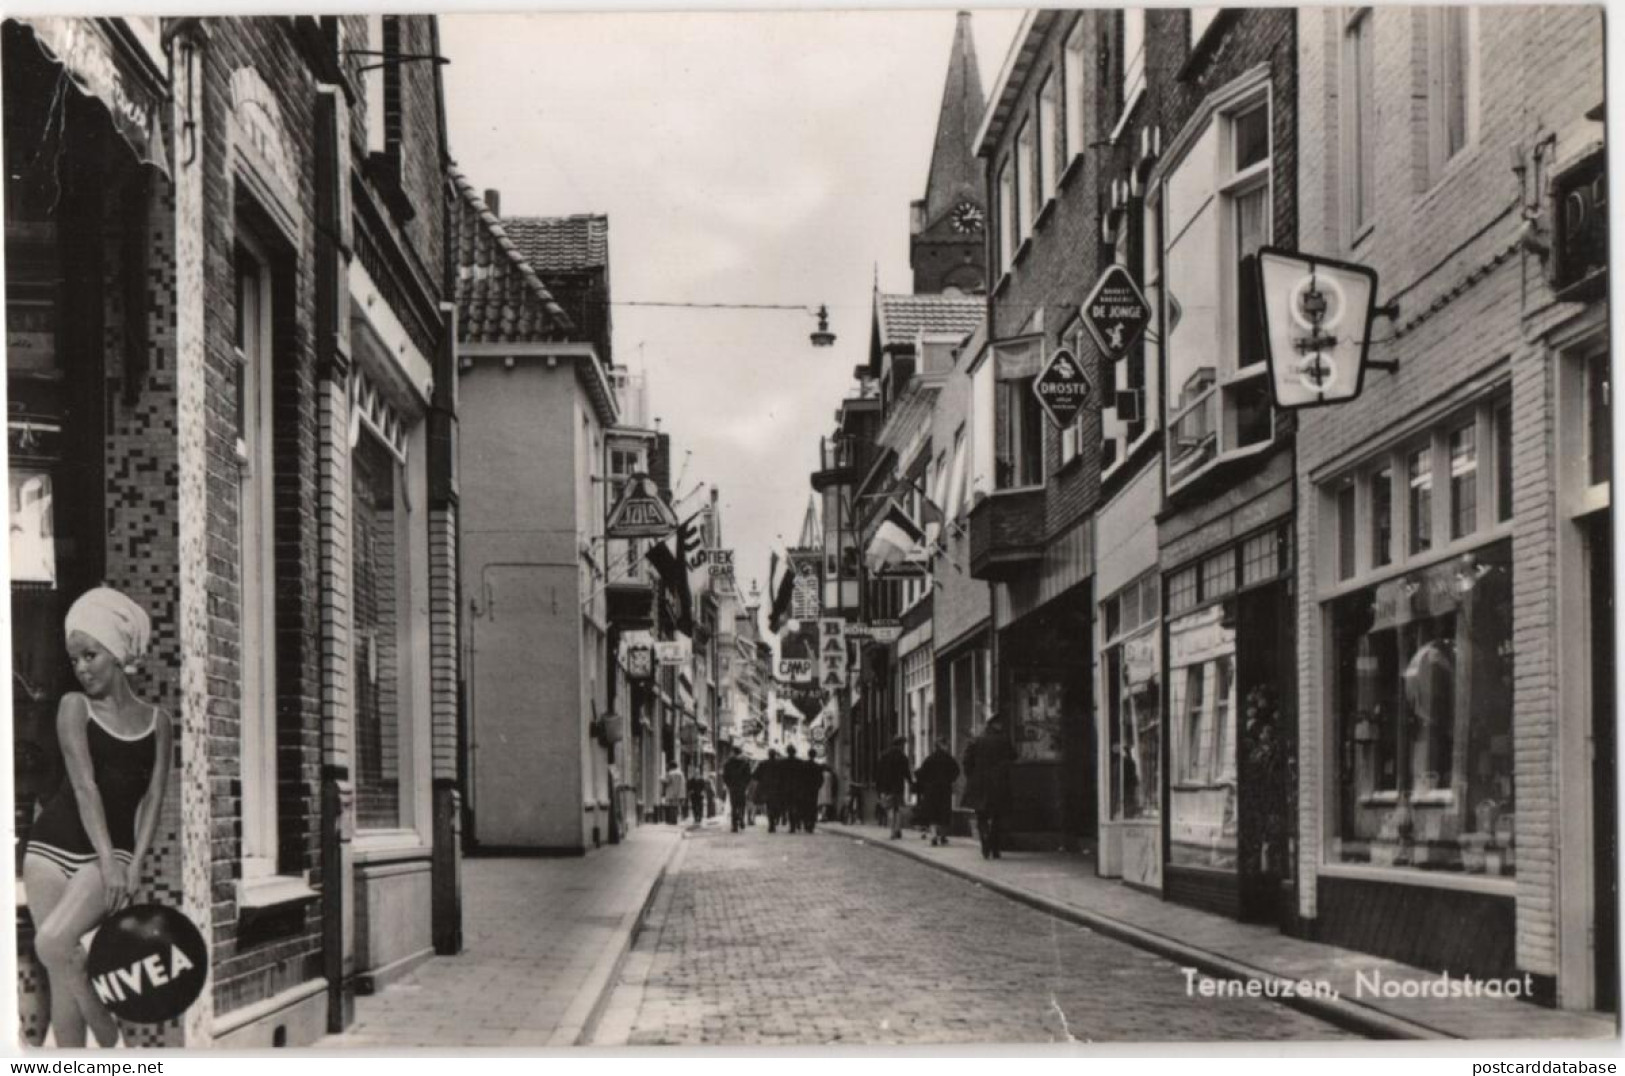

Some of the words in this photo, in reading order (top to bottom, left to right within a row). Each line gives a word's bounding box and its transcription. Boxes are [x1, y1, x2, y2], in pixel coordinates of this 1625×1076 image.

[1092, 305, 1106, 318] DE
[1109, 305, 1142, 318] JONGE
[1041, 382, 1087, 395] DROSTE
[824, 621, 841, 685] BATA
[92, 943, 194, 1004] NIVEA
